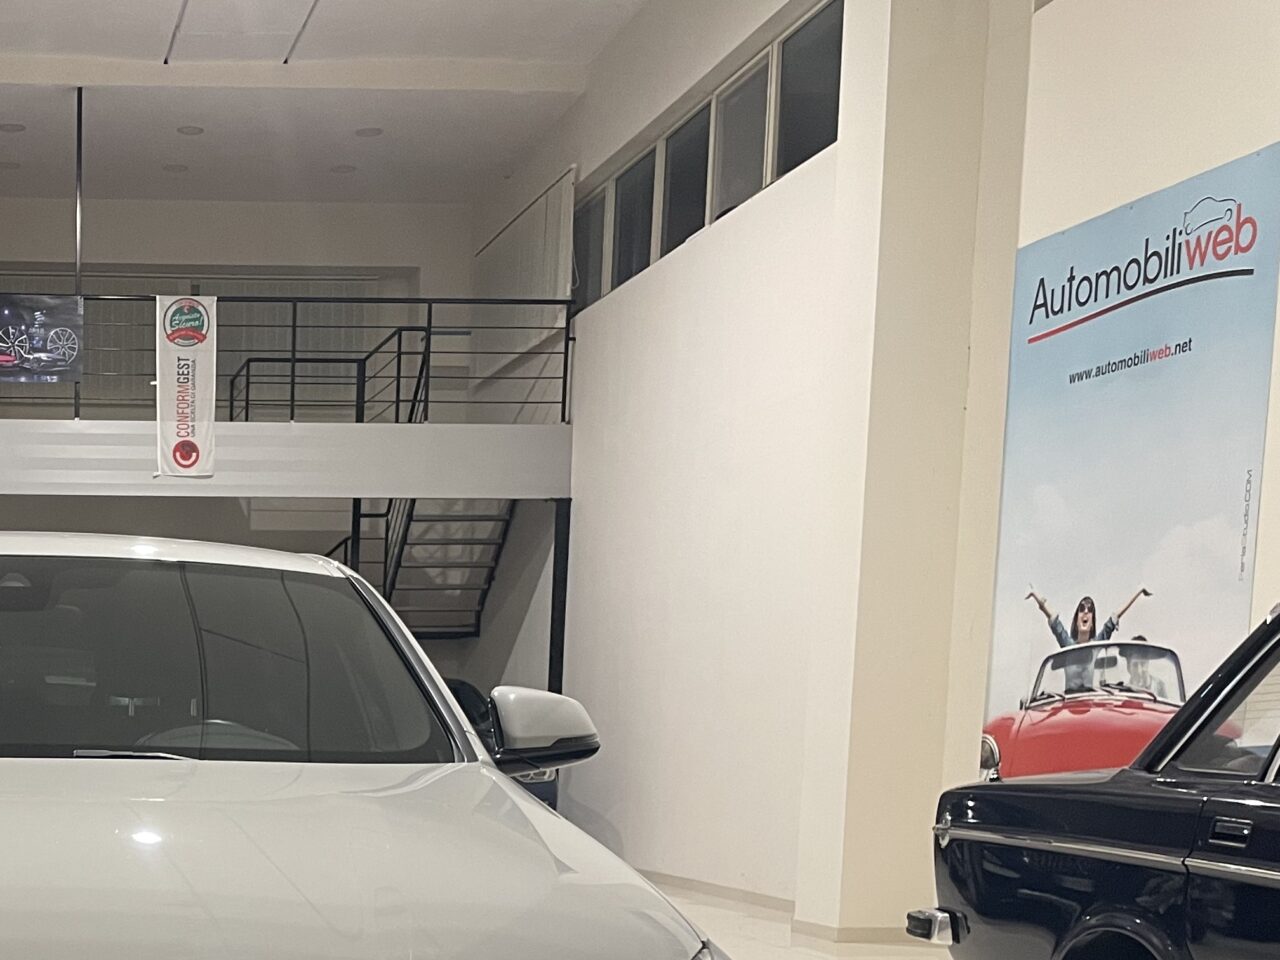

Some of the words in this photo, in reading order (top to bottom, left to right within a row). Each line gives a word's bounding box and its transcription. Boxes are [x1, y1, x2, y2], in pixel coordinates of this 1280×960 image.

[1029, 202, 1258, 325] Automobiliweb
[176, 356, 190, 438] CONFORMGEST
[1069, 337, 1192, 384] www.automobiliweb.net
